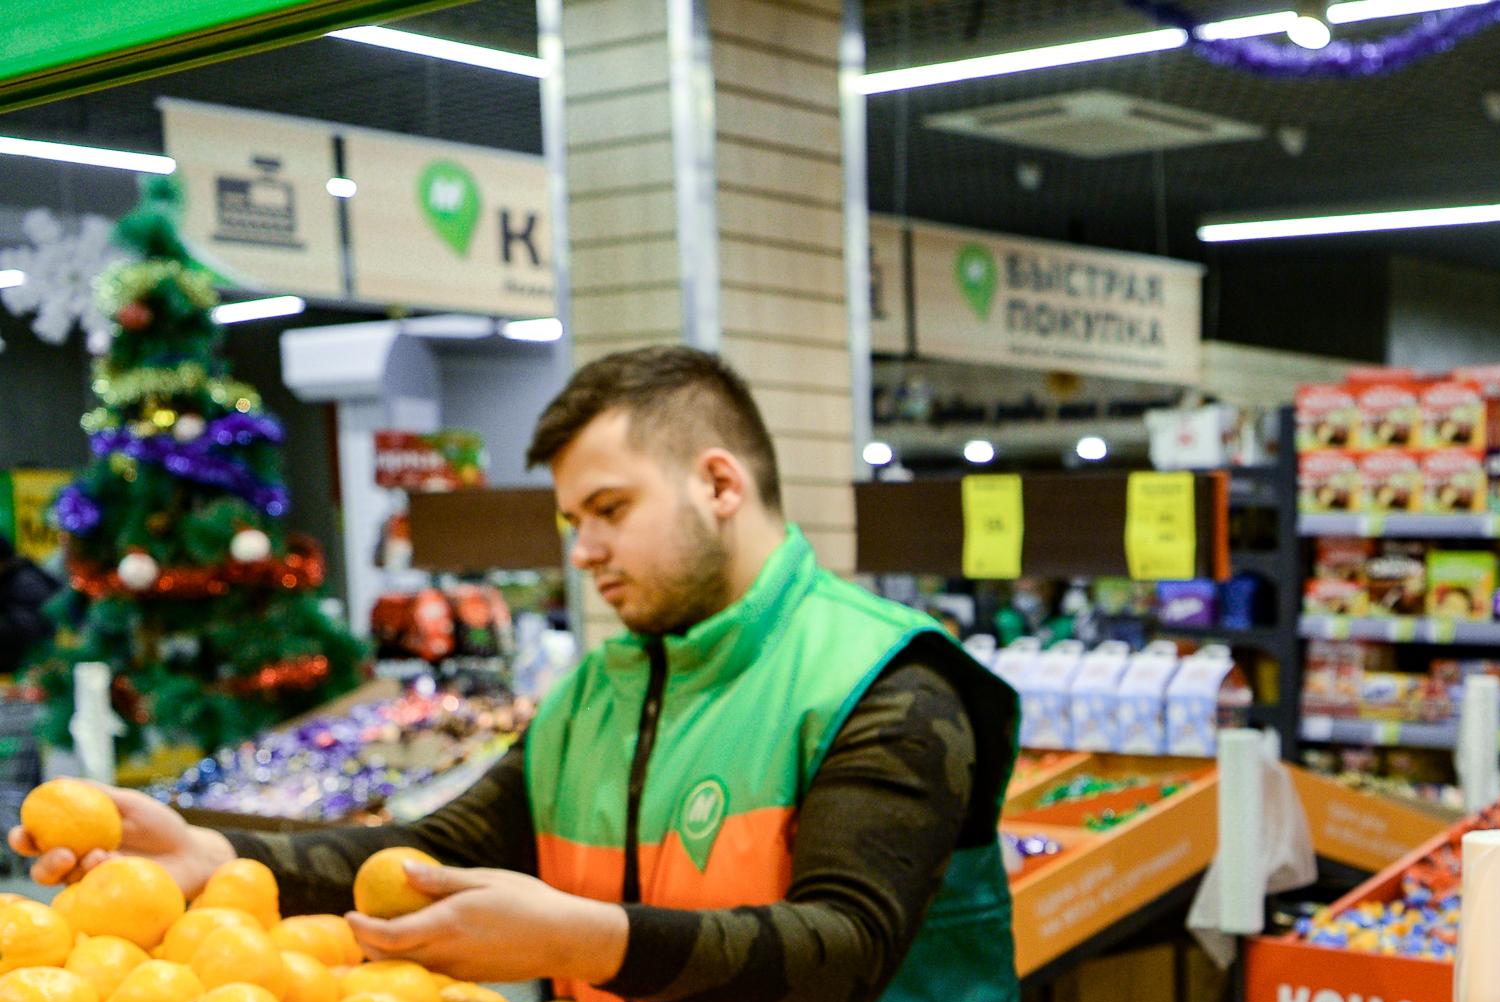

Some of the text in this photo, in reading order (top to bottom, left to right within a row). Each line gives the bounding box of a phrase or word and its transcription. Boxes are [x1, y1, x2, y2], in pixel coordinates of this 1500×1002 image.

[499, 208, 552, 266] К
[1005, 252, 1164, 304] БЫСТРАЯ
[1006, 298, 1164, 347] ПОКУПКА
